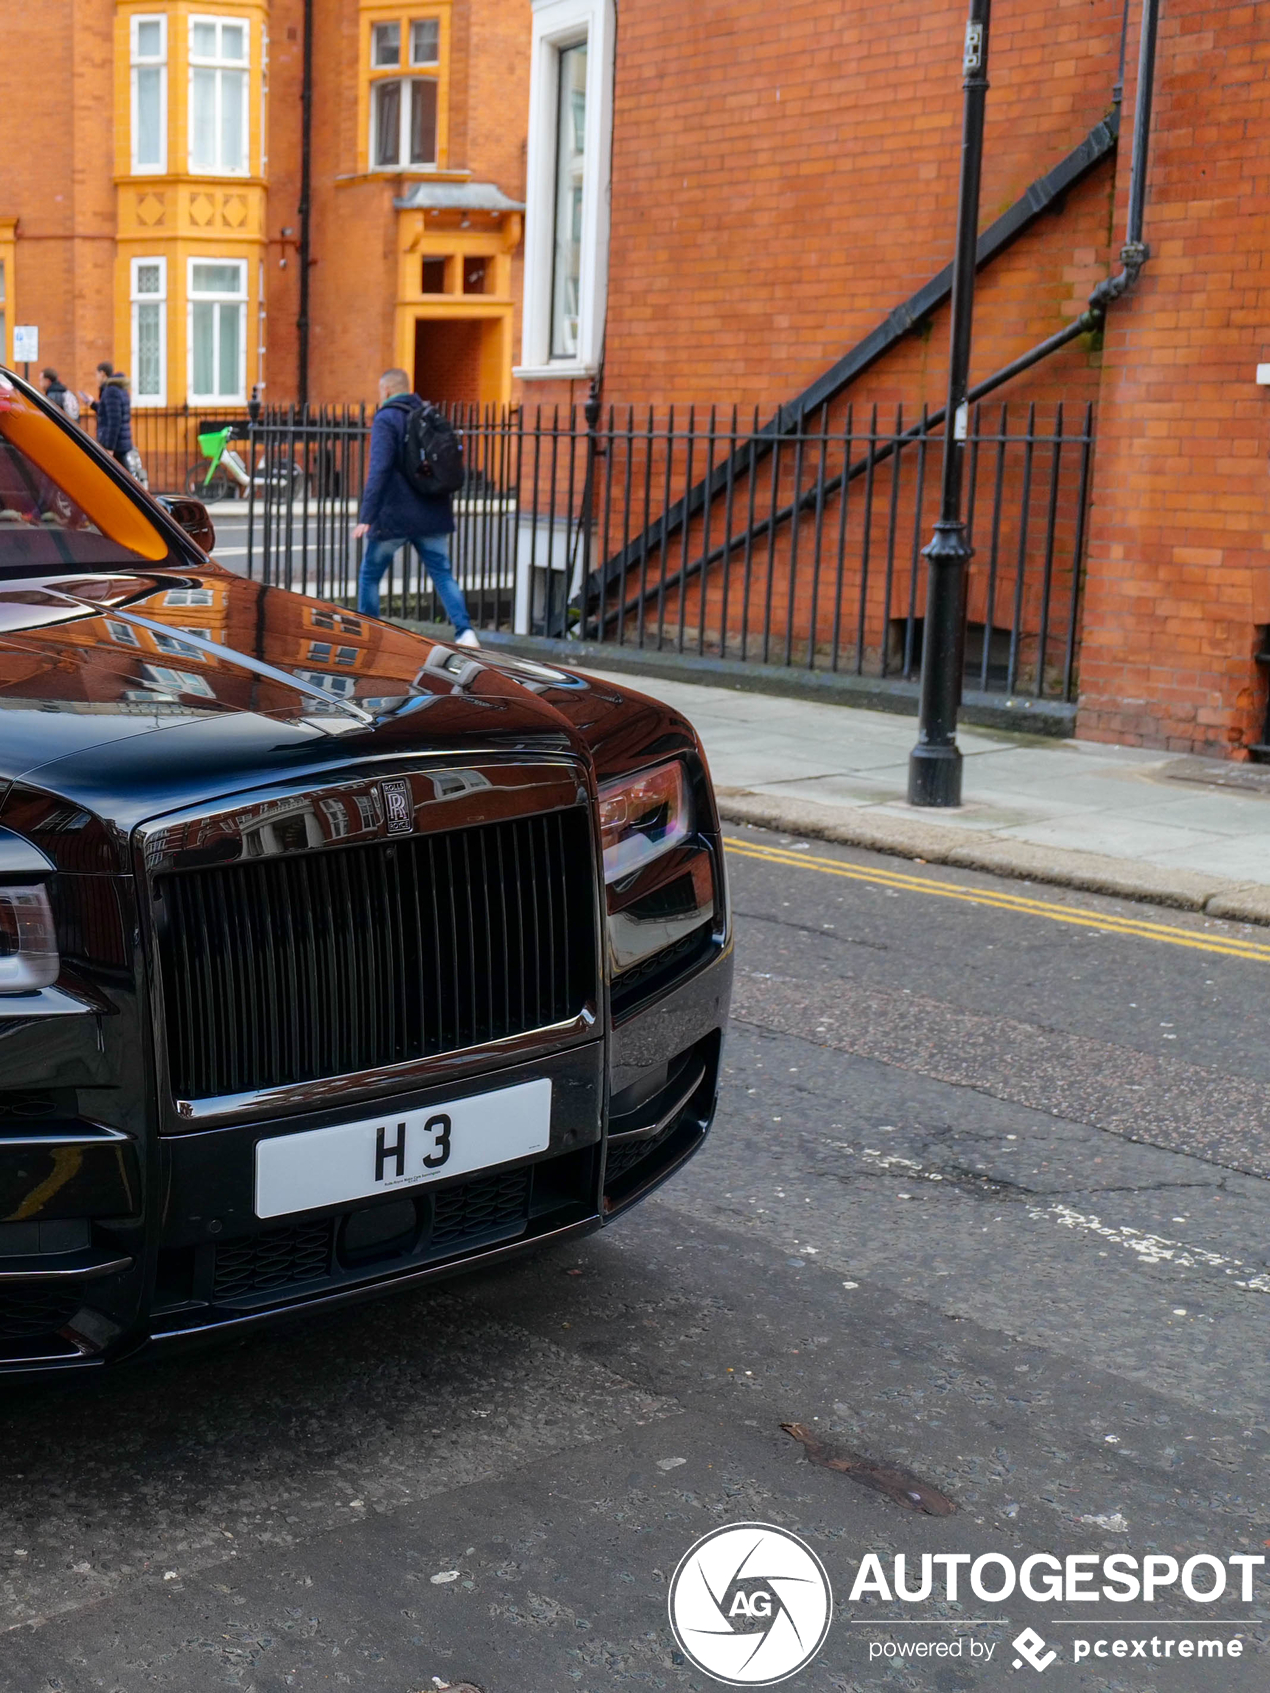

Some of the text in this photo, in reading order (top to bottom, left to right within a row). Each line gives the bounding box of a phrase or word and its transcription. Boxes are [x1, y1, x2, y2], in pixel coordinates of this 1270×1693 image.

[384, 783, 404, 791] ROLLS
[389, 821, 409, 830] ROYCE
[375, 1113, 452, 1182] H 3
